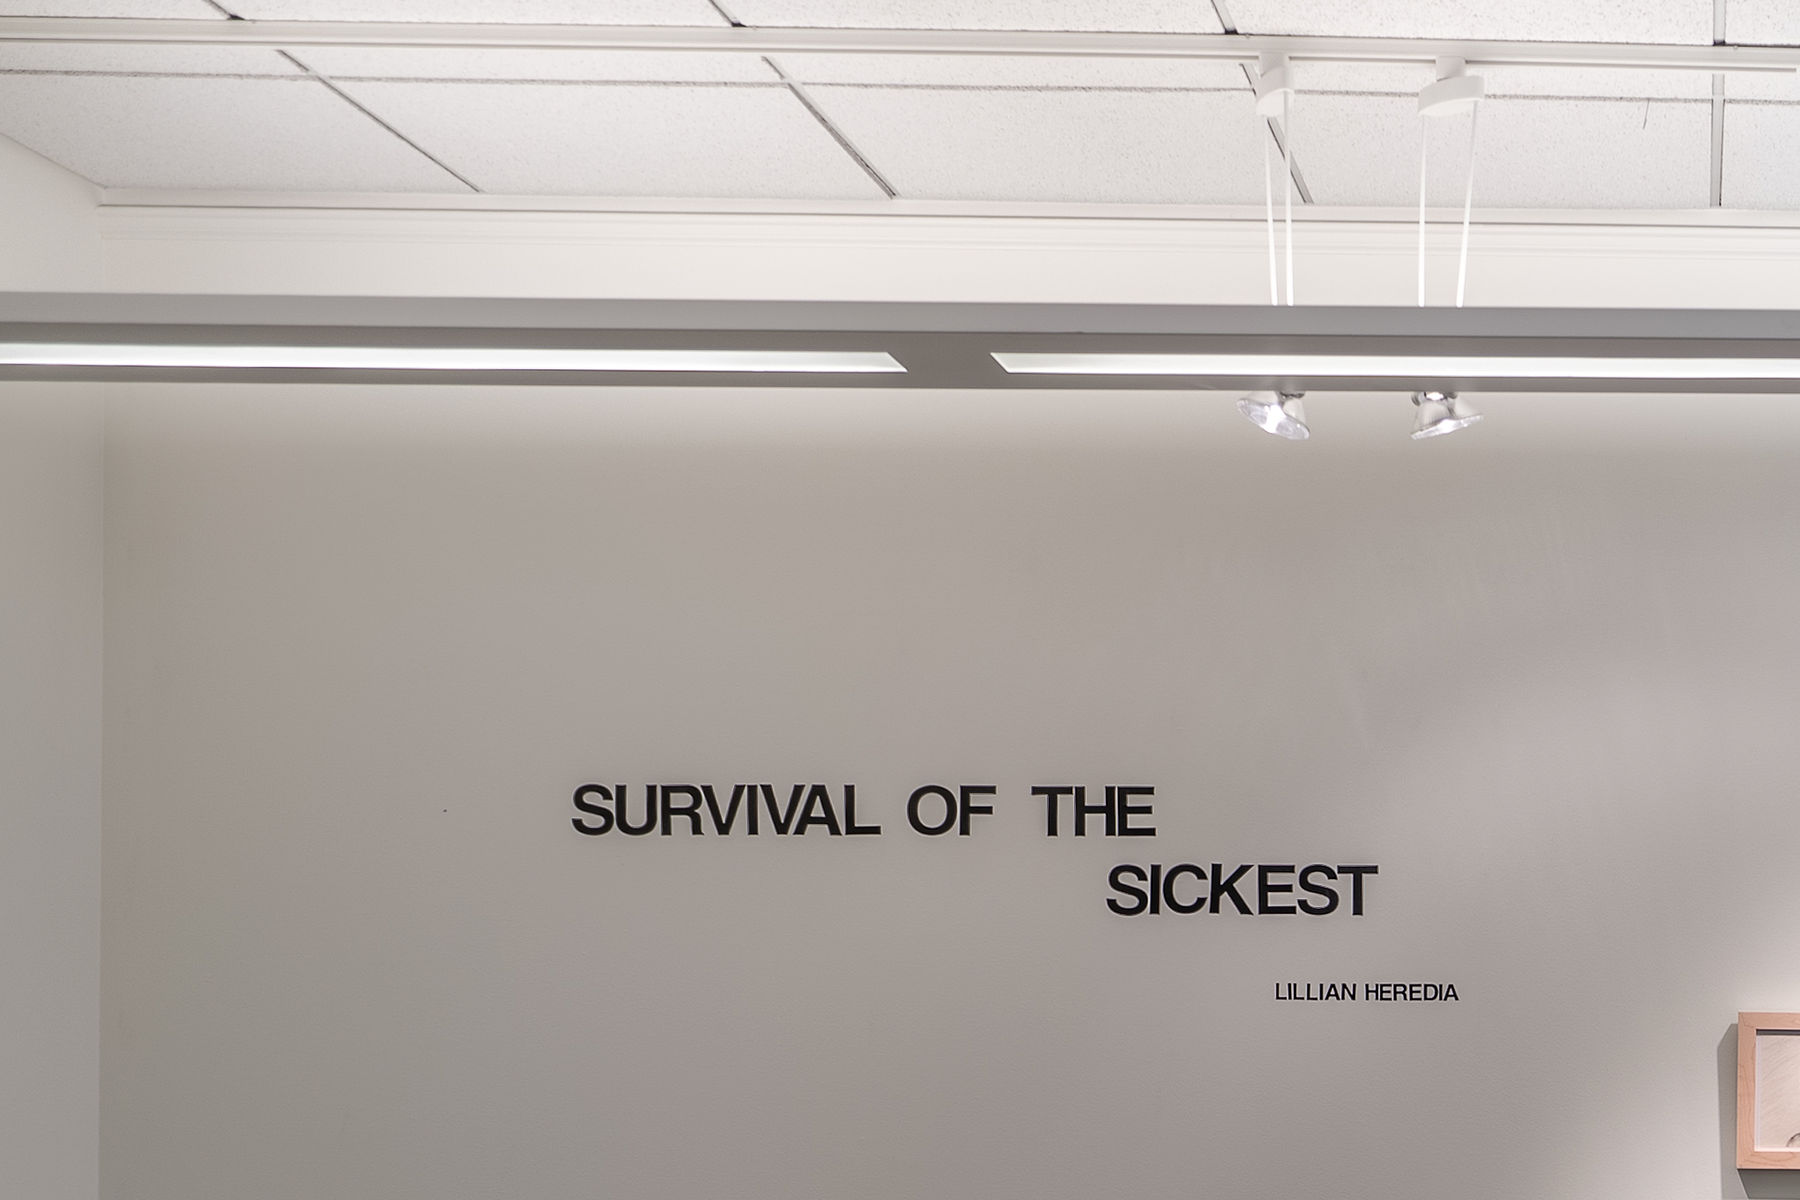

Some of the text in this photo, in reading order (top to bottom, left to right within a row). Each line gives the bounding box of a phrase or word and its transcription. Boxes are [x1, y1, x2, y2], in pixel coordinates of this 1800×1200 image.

[571, 783, 1157, 837] SURVIVAL OF THE
[1105, 863, 1379, 917] SICKEST
[1275, 982, 1460, 1002] LILLIAN HEREDIA
